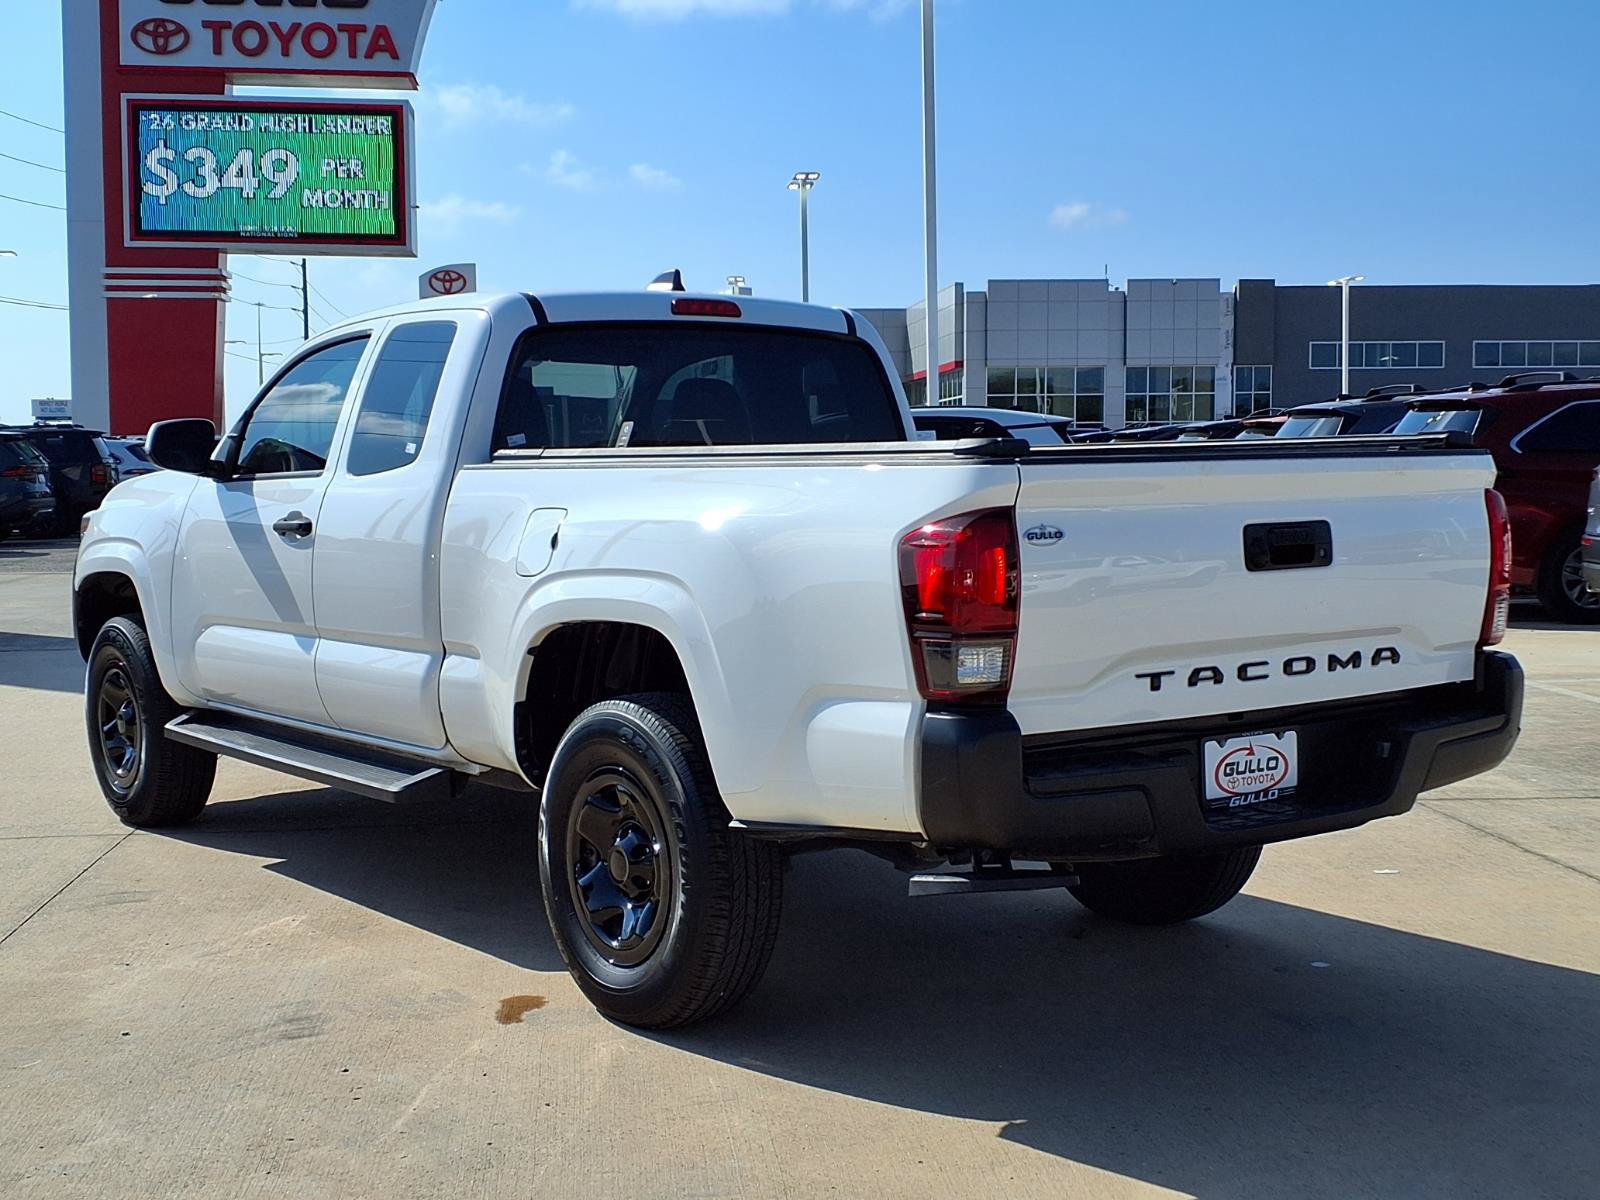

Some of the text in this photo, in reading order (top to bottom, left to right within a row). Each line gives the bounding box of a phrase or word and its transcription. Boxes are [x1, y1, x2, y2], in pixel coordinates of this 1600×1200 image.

[201, 19, 399, 60] TOYOTA
[181, 114, 253, 131] GRAND
[260, 116, 392, 135] HIGHLANDER
[142, 139, 300, 205] $349
[322, 158, 365, 179] PER
[302, 188, 389, 209] MONTH
[1026, 531, 1064, 541] GULLO
[1135, 646, 1401, 692] TACOMA
[1223, 756, 1280, 777] GULLO
[1240, 773, 1276, 787] TOYOTA
[1229, 789, 1279, 808] GULLO
